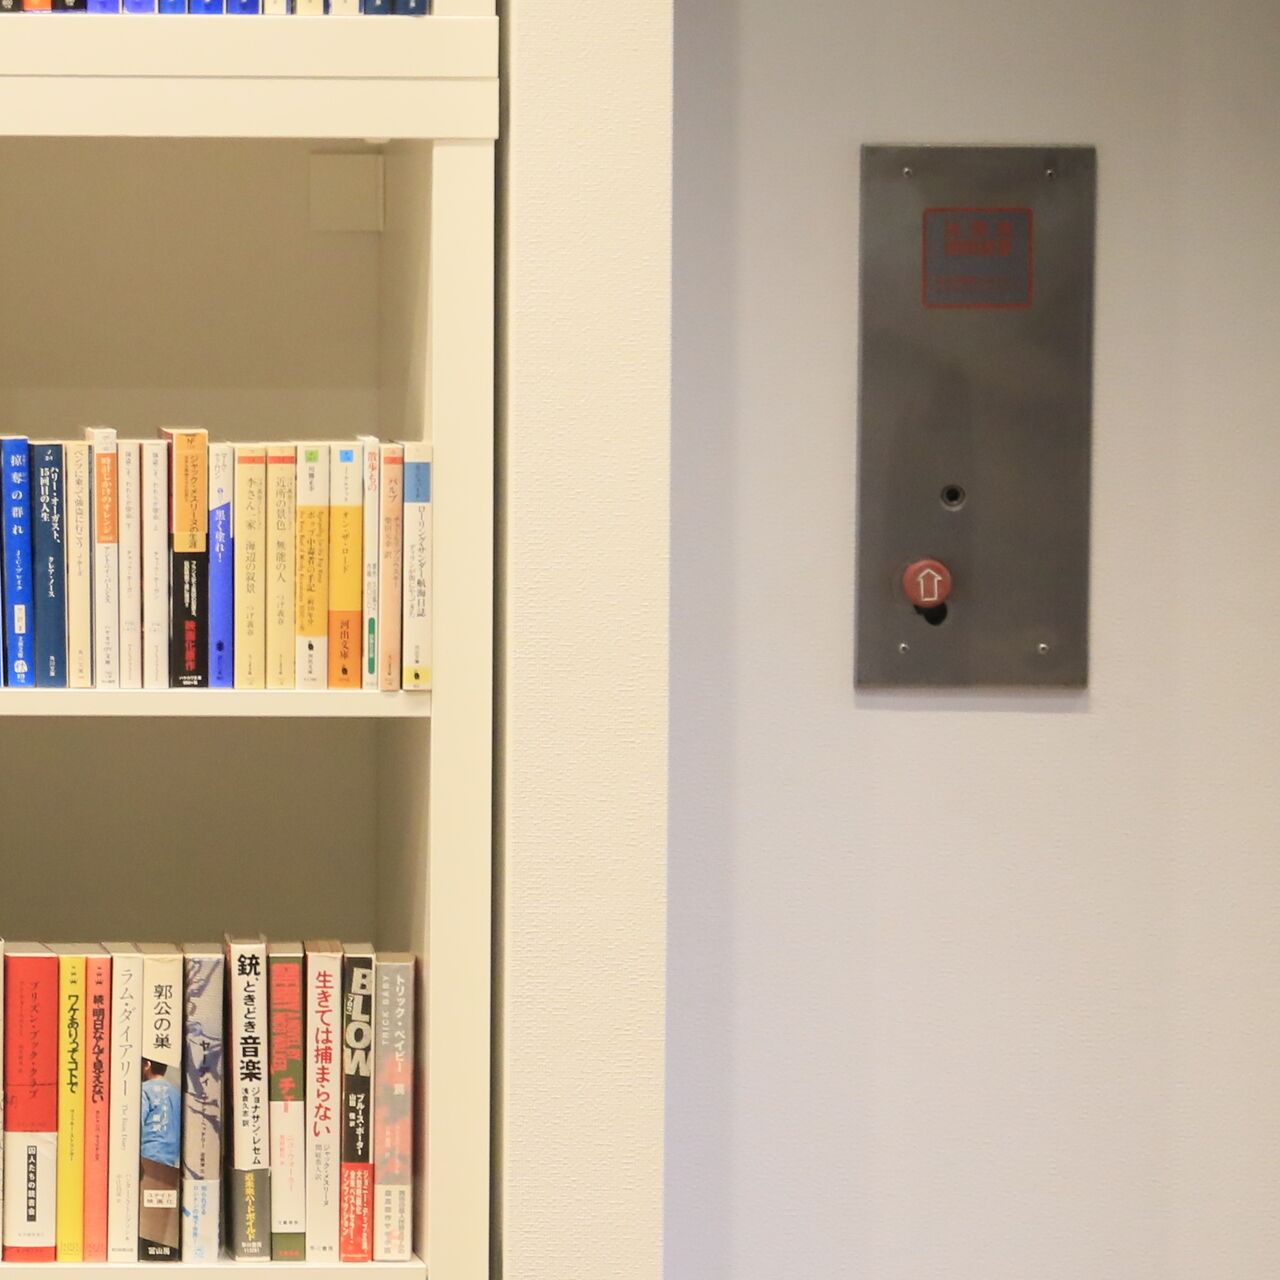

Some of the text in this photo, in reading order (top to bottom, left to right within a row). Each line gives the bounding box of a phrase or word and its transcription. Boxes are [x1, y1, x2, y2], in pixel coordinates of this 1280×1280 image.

[40, 468, 50, 521] 15回目の人生
[340, 620, 350, 660] 河出文庫
[28, 981, 40, 1099] プリズン・ブック・クラブ
[67, 994, 79, 1094] ワケありってコトで
[119, 970, 133, 1096] ラム・ダイアリー
[152, 984, 173, 1050] 郭公の巣
[237, 954, 262, 1082] 銃、ときどき音楽
[313, 971, 334, 1138] 生きては捕まらない
[344, 968, 372, 1076] BLOW
[394, 974, 403, 1074] トリック・ベイビー
[251, 1087, 262, 1165] ジョナサン・レセム
[356, 1093, 365, 1156] ブルース・ポーター
[28, 1146, 37, 1215] 囚人たちの読書会
[244, 1172, 257, 1241] 近未来ハードボイルド
